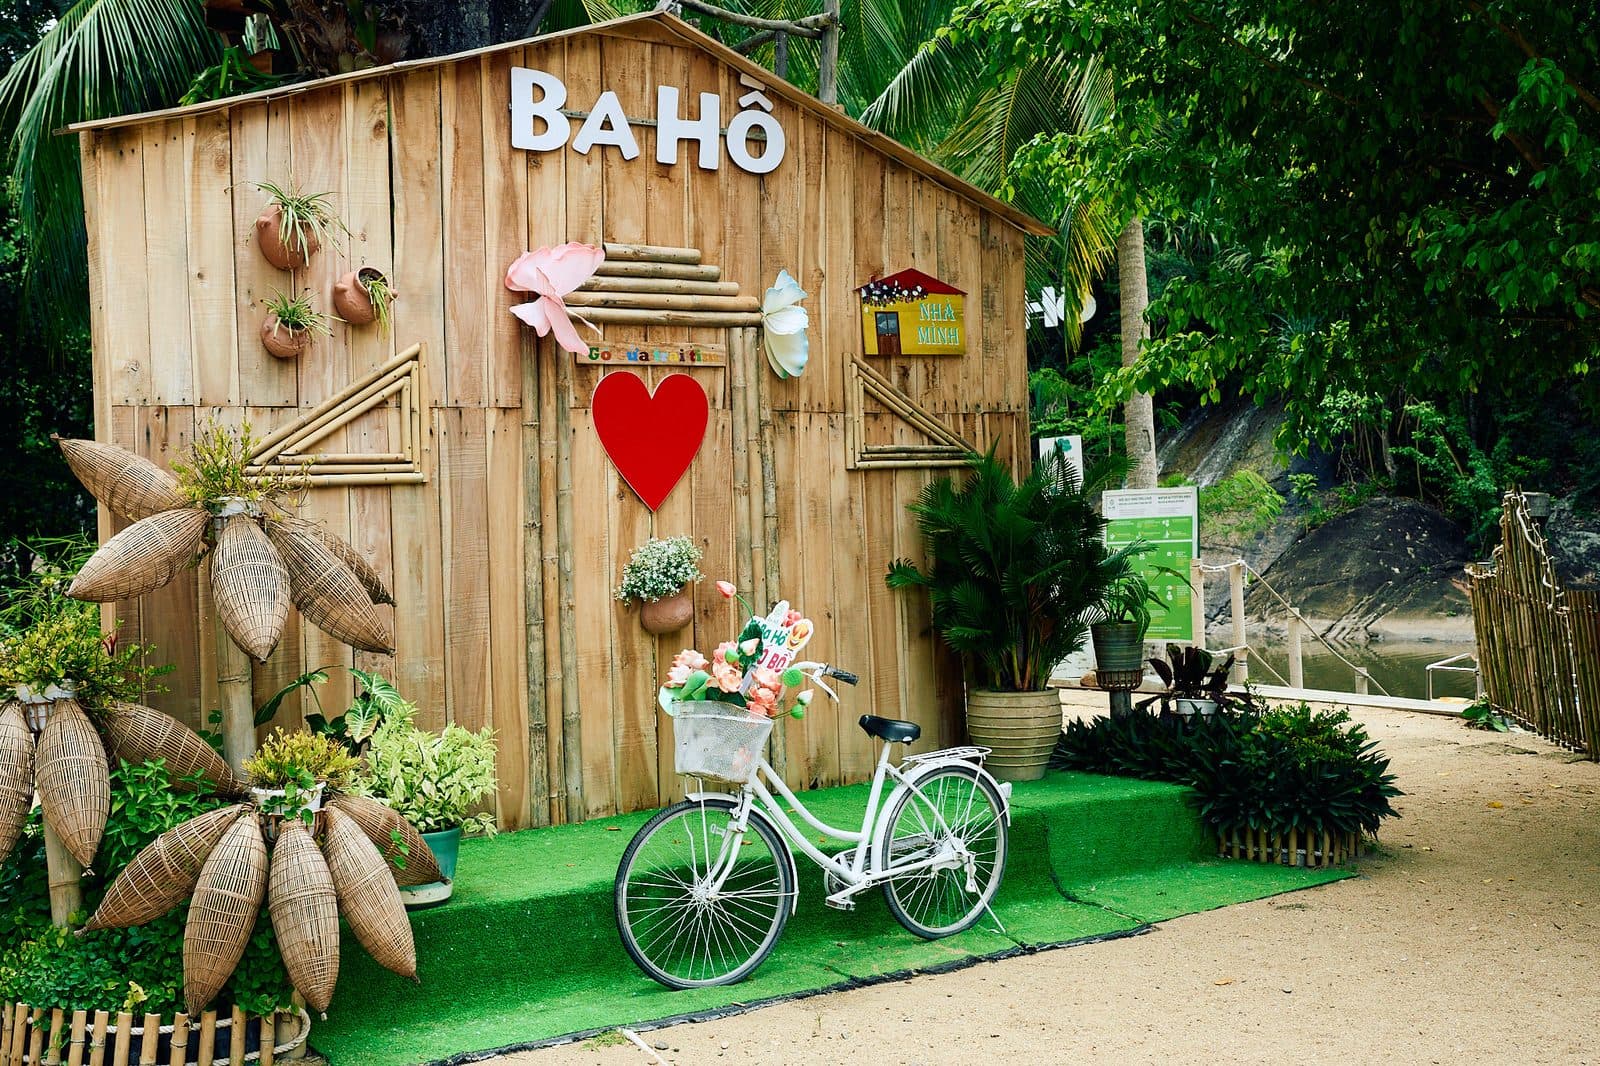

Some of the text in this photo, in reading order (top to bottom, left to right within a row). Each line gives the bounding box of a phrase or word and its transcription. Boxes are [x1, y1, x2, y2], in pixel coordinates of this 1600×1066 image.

[511, 66, 640, 160] BA
[919, 299, 956, 321] NHÀ
[917, 323, 960, 345] MÌNH
